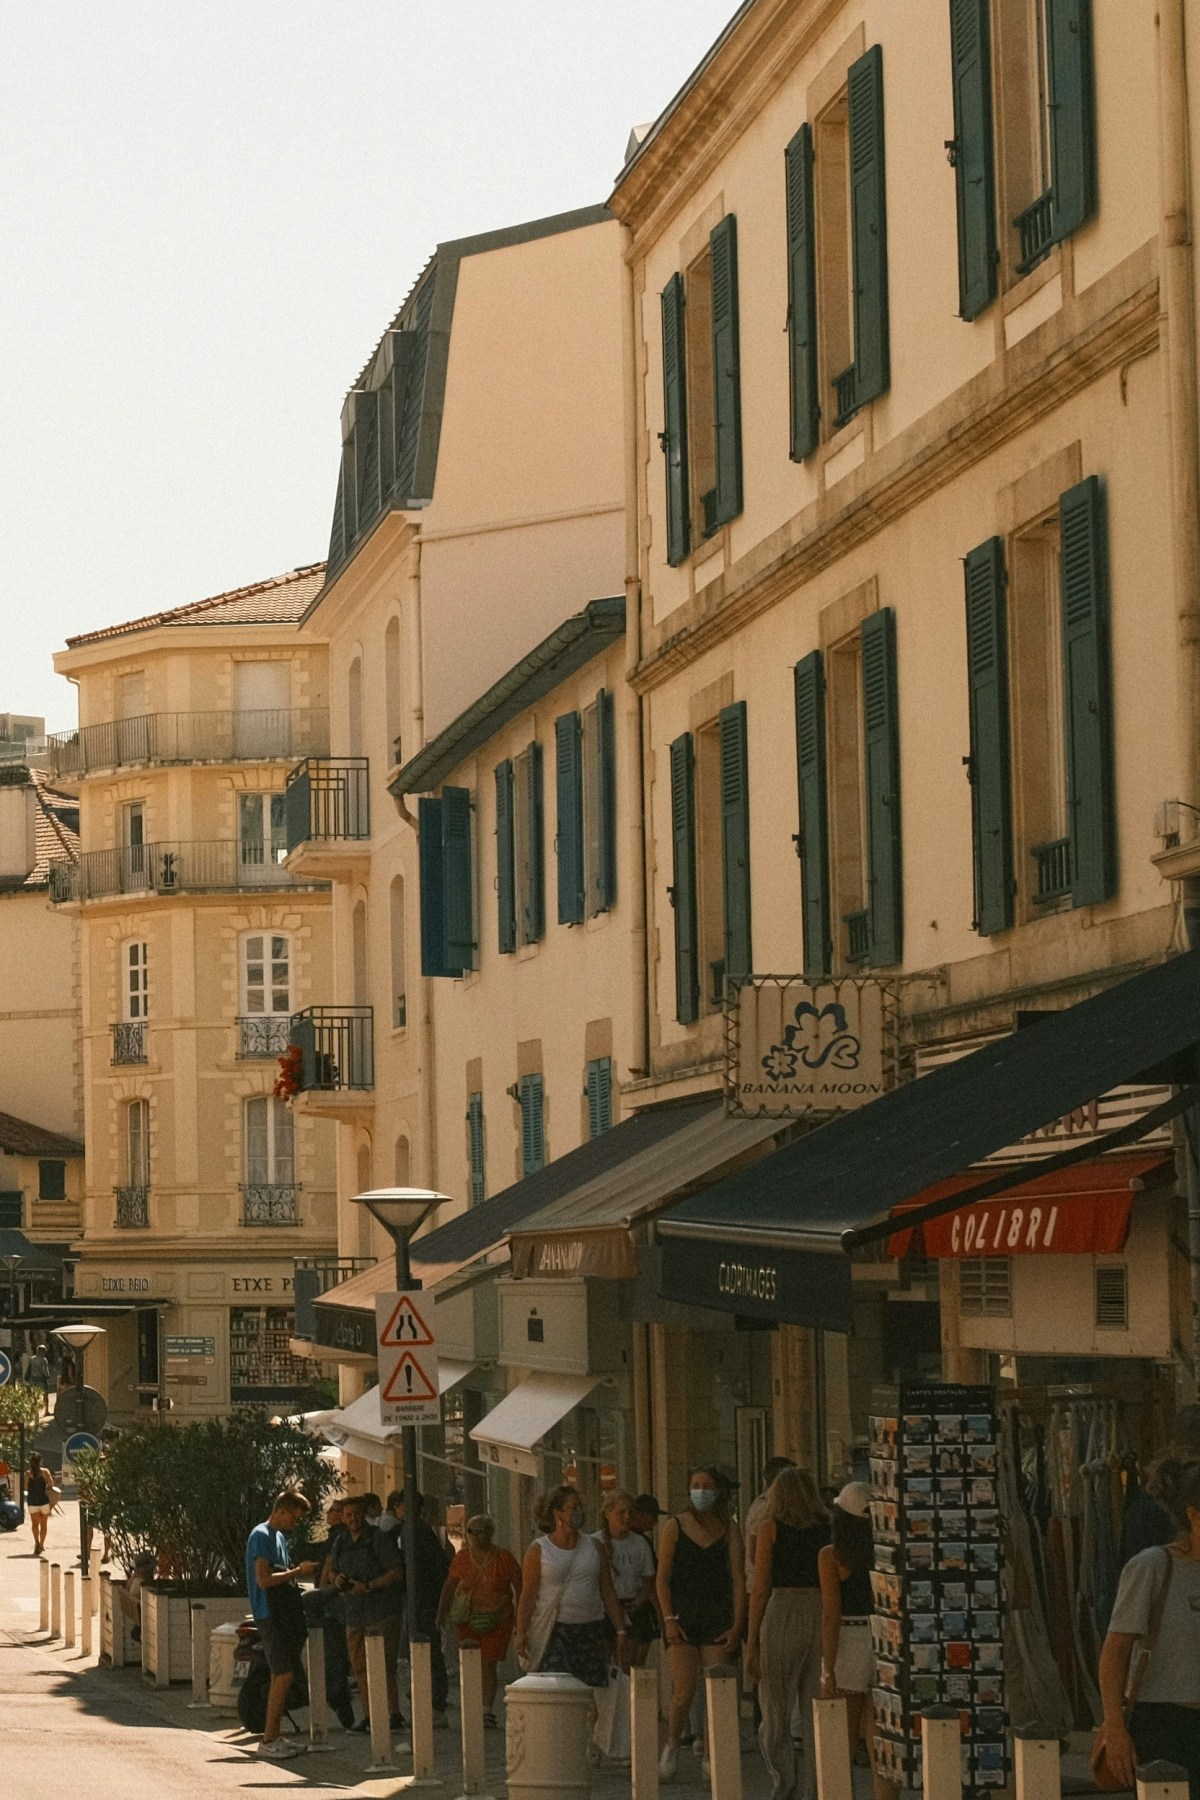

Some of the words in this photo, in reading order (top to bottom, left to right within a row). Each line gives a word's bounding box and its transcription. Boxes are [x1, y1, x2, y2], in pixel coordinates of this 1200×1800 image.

[742, 1083, 814, 1094] BANANA
[820, 1083, 882, 1094] MOON
[952, 1206, 1057, 1252] COLIBRI
[102, 1278, 124, 1291] ETXE
[232, 1278, 273, 1291] ETXE
